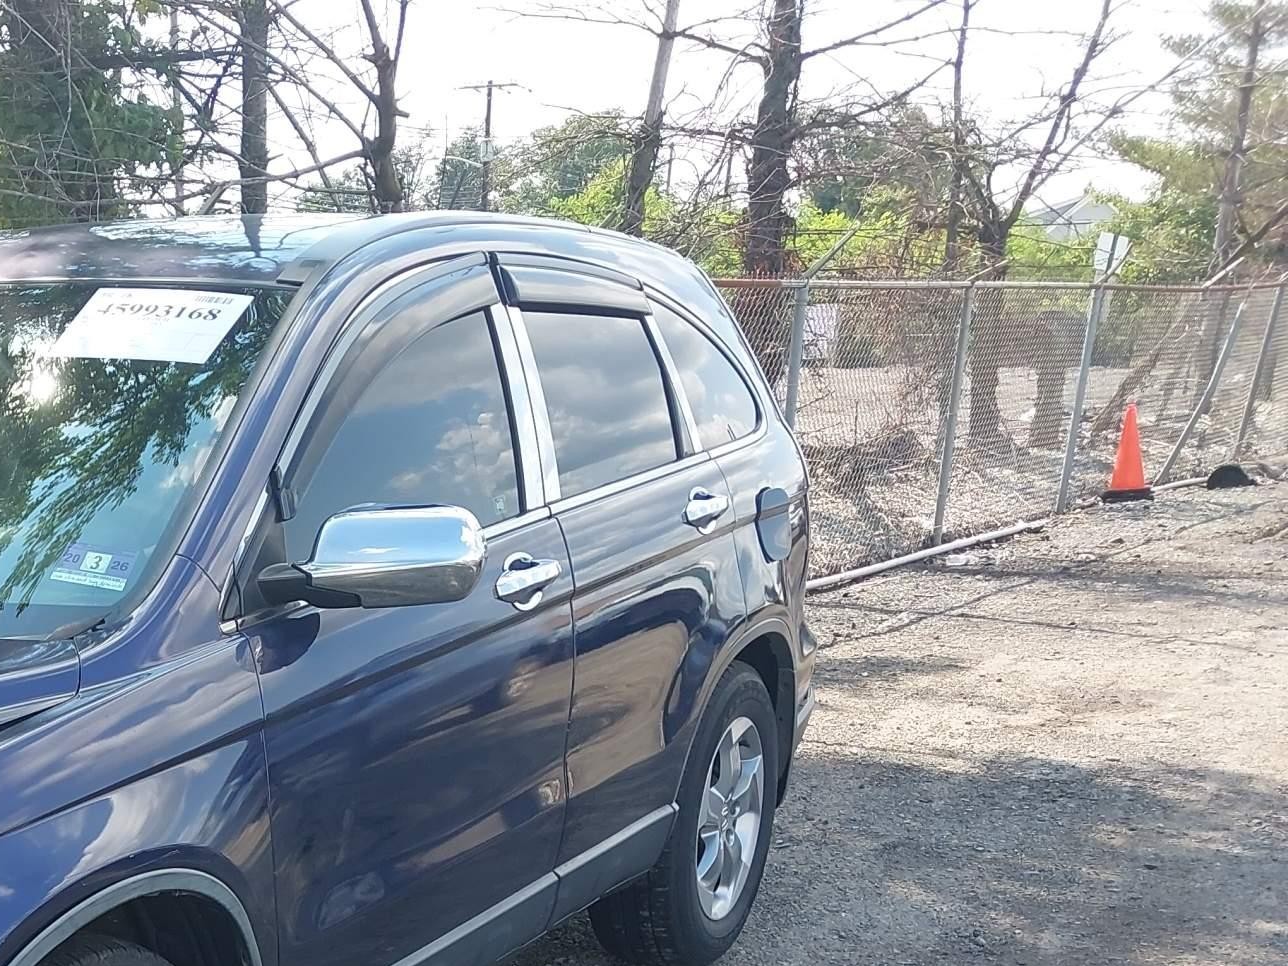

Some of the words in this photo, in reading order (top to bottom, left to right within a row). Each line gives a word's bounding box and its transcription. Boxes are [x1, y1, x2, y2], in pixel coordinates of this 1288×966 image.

[97, 303, 222, 321] 45993168
[64, 553, 81, 563] 20
[90, 555, 103, 569] 3
[111, 561, 129, 571] 26
